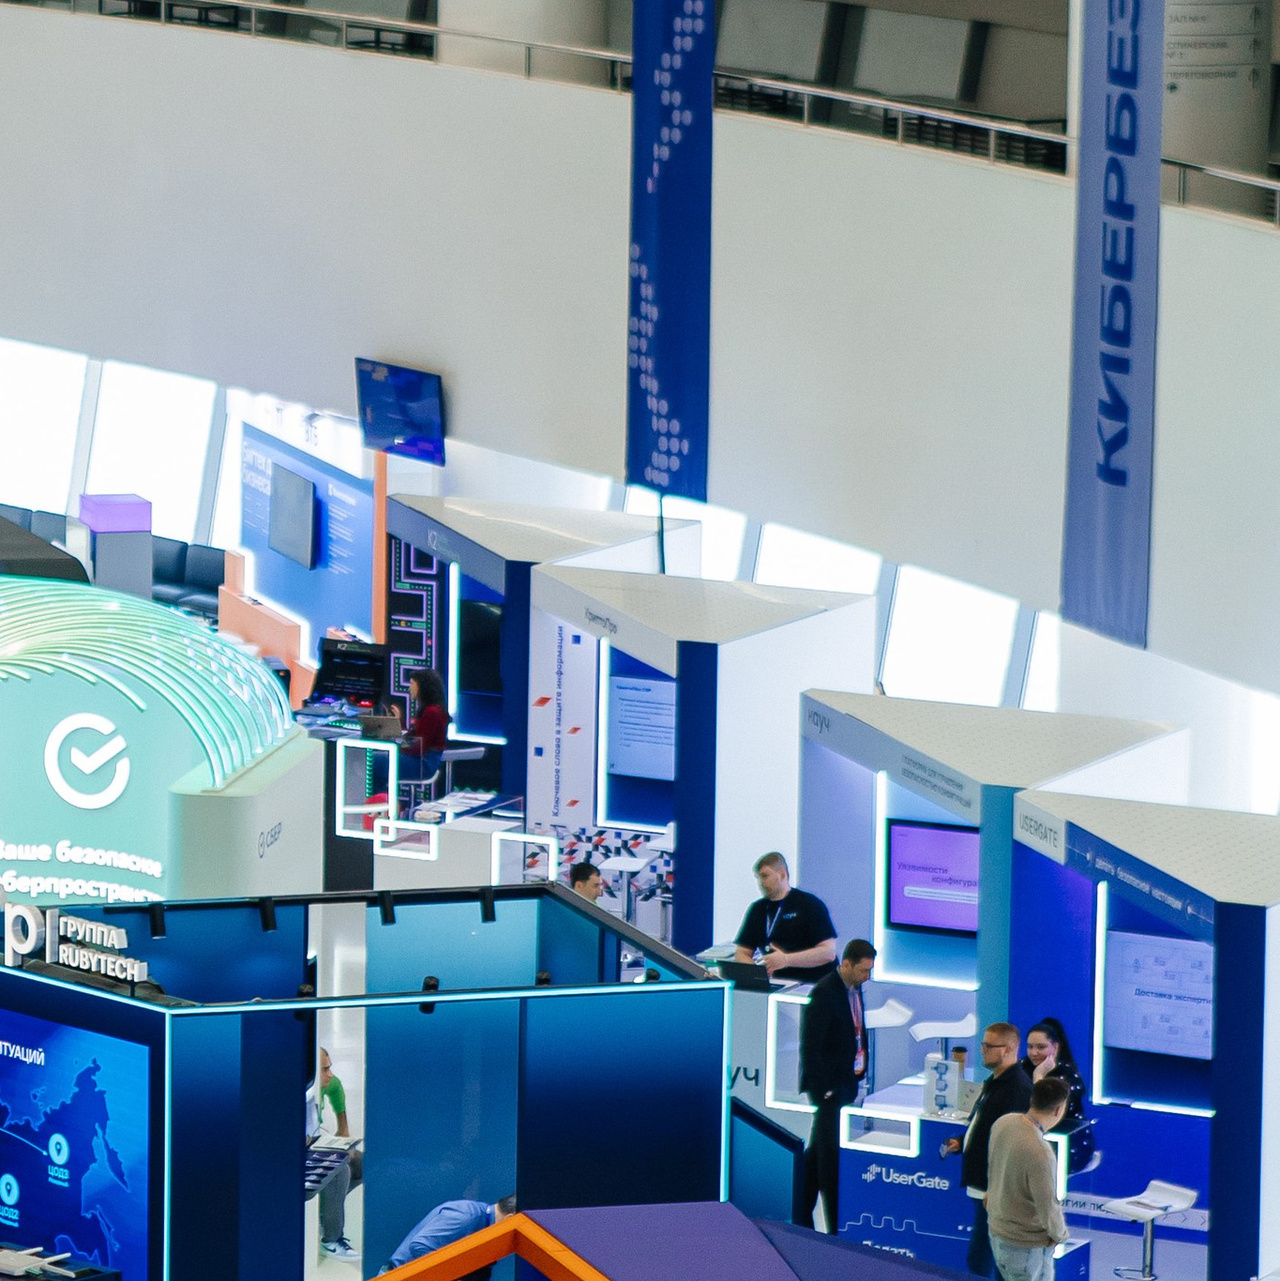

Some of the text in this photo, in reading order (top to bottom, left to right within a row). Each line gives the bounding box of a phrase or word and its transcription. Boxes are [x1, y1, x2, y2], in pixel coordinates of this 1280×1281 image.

[556, 625, 564, 690] информации
[554, 692, 562, 728] защите
[551, 769, 561, 818] Ключевое
[1019, 813, 1058, 849] USERGATE
[55, 839, 163, 878] безопасное
[896, 862, 949, 875] Уязвимости
[58, 916, 128, 949] ГРУППА
[58, 943, 148, 983] RUBYTECH
[881, 1166, 950, 1191] UserGate
